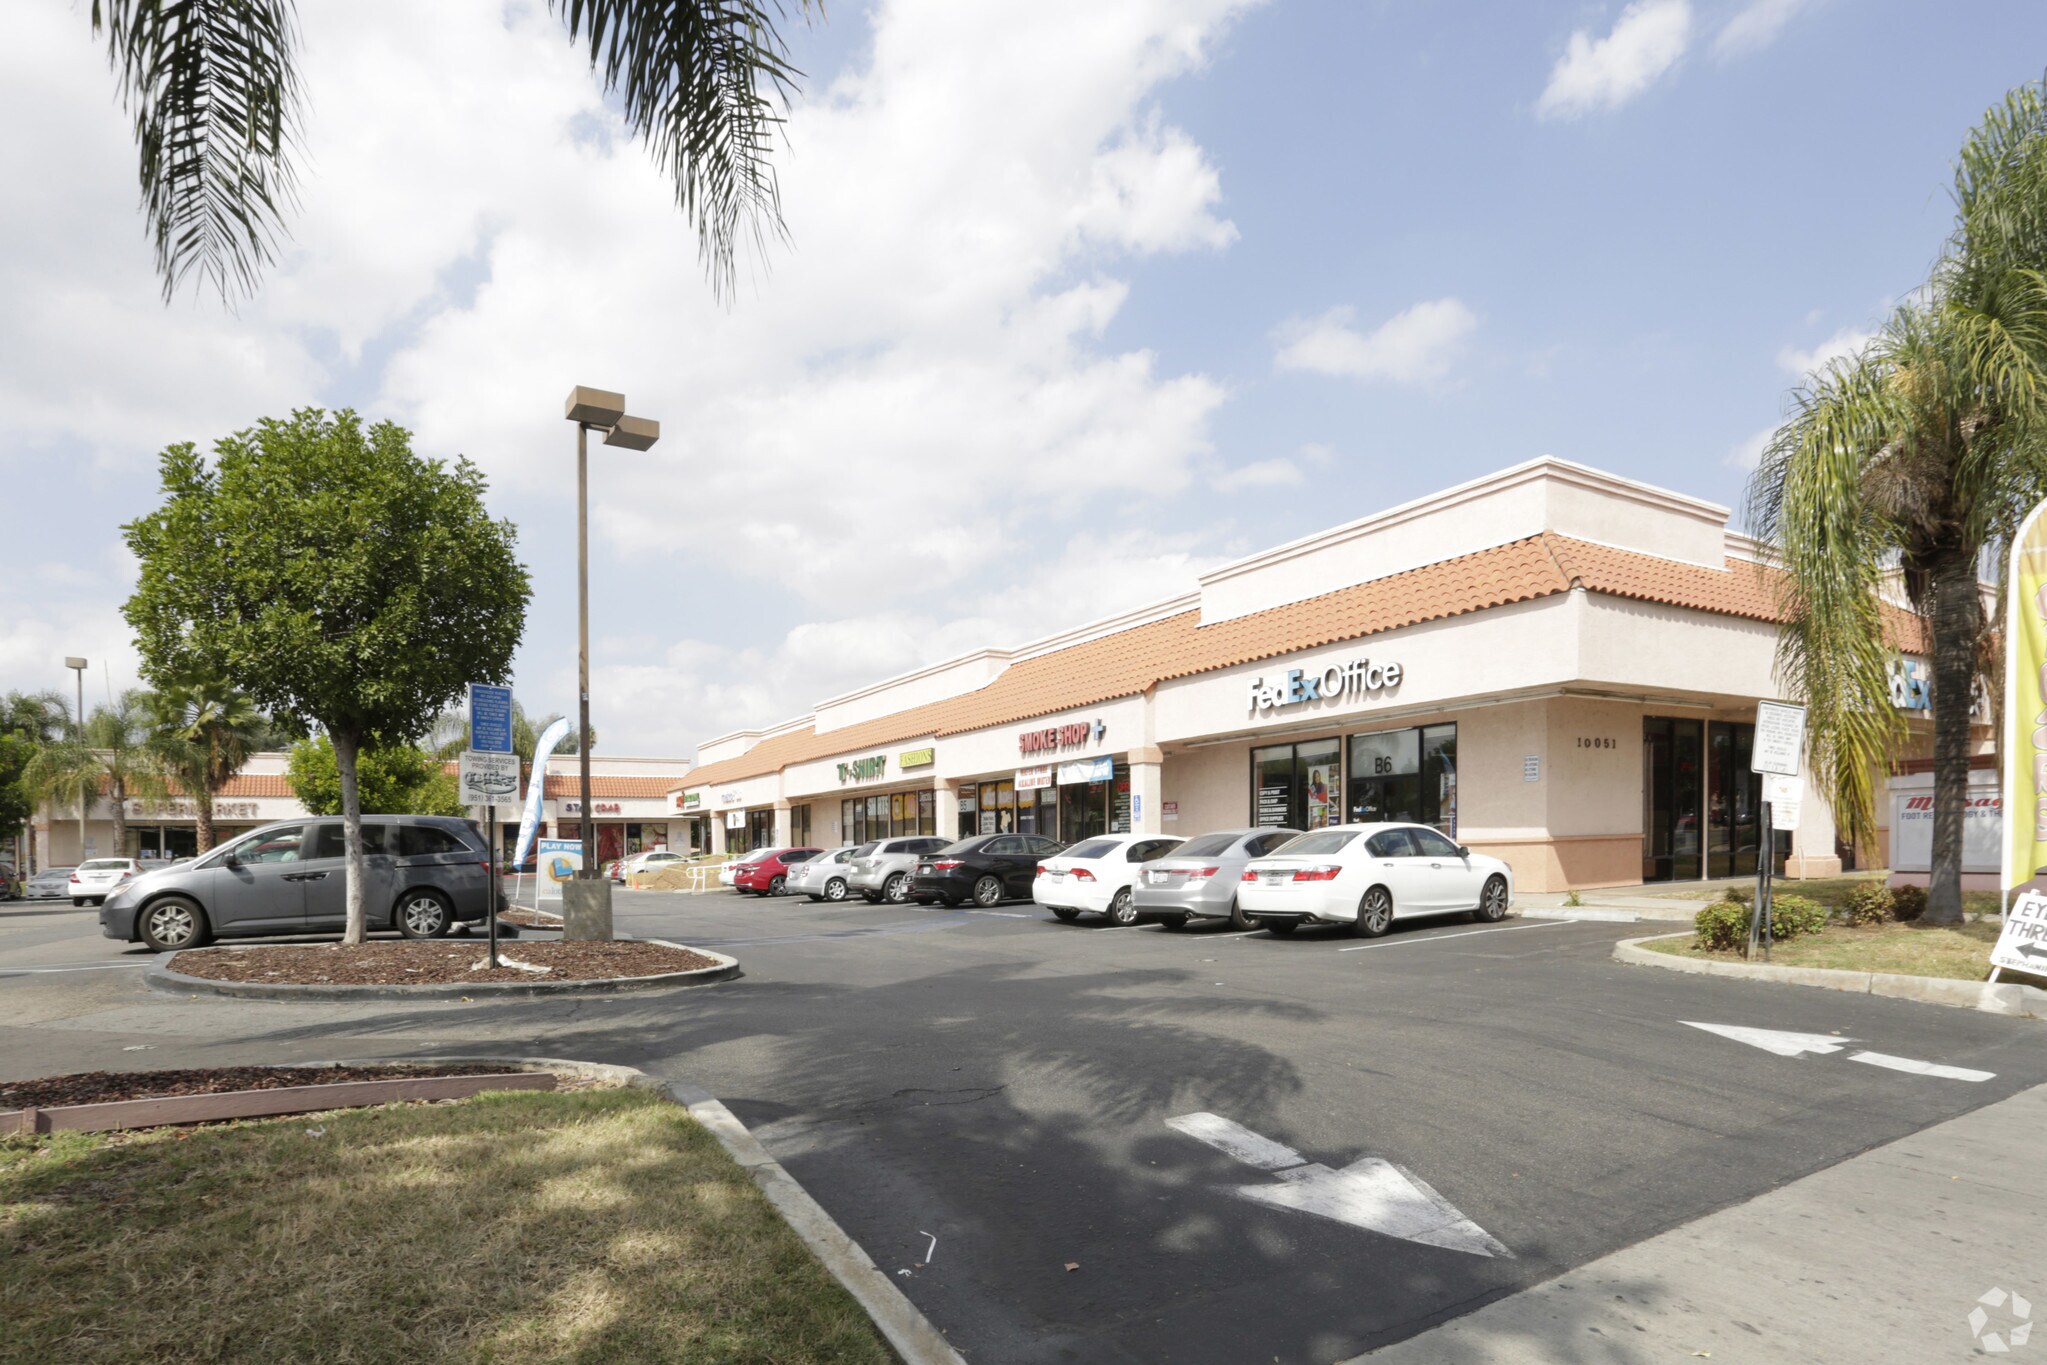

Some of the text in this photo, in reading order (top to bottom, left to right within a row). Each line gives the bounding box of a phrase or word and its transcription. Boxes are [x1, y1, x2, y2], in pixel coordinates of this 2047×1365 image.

[1247, 657, 1402, 711] FedEx Office
[1019, 721, 1089, 752] SMOKE SHOP
[1577, 737, 1616, 749] 10051
[465, 755, 516, 765] TOWING SERVICES
[901, 750, 933, 767] FASHIONS
[471, 763, 500, 771] PROVIDED
[1374, 756, 1392, 774] B6
[468, 794, 484, 802] (951)
[131, 802, 259, 818] SUPERMRKET
[594, 803, 621, 813] CRAB
[1901, 812, 1921, 820] FOOT
[563, 843, 582, 851] NOW
